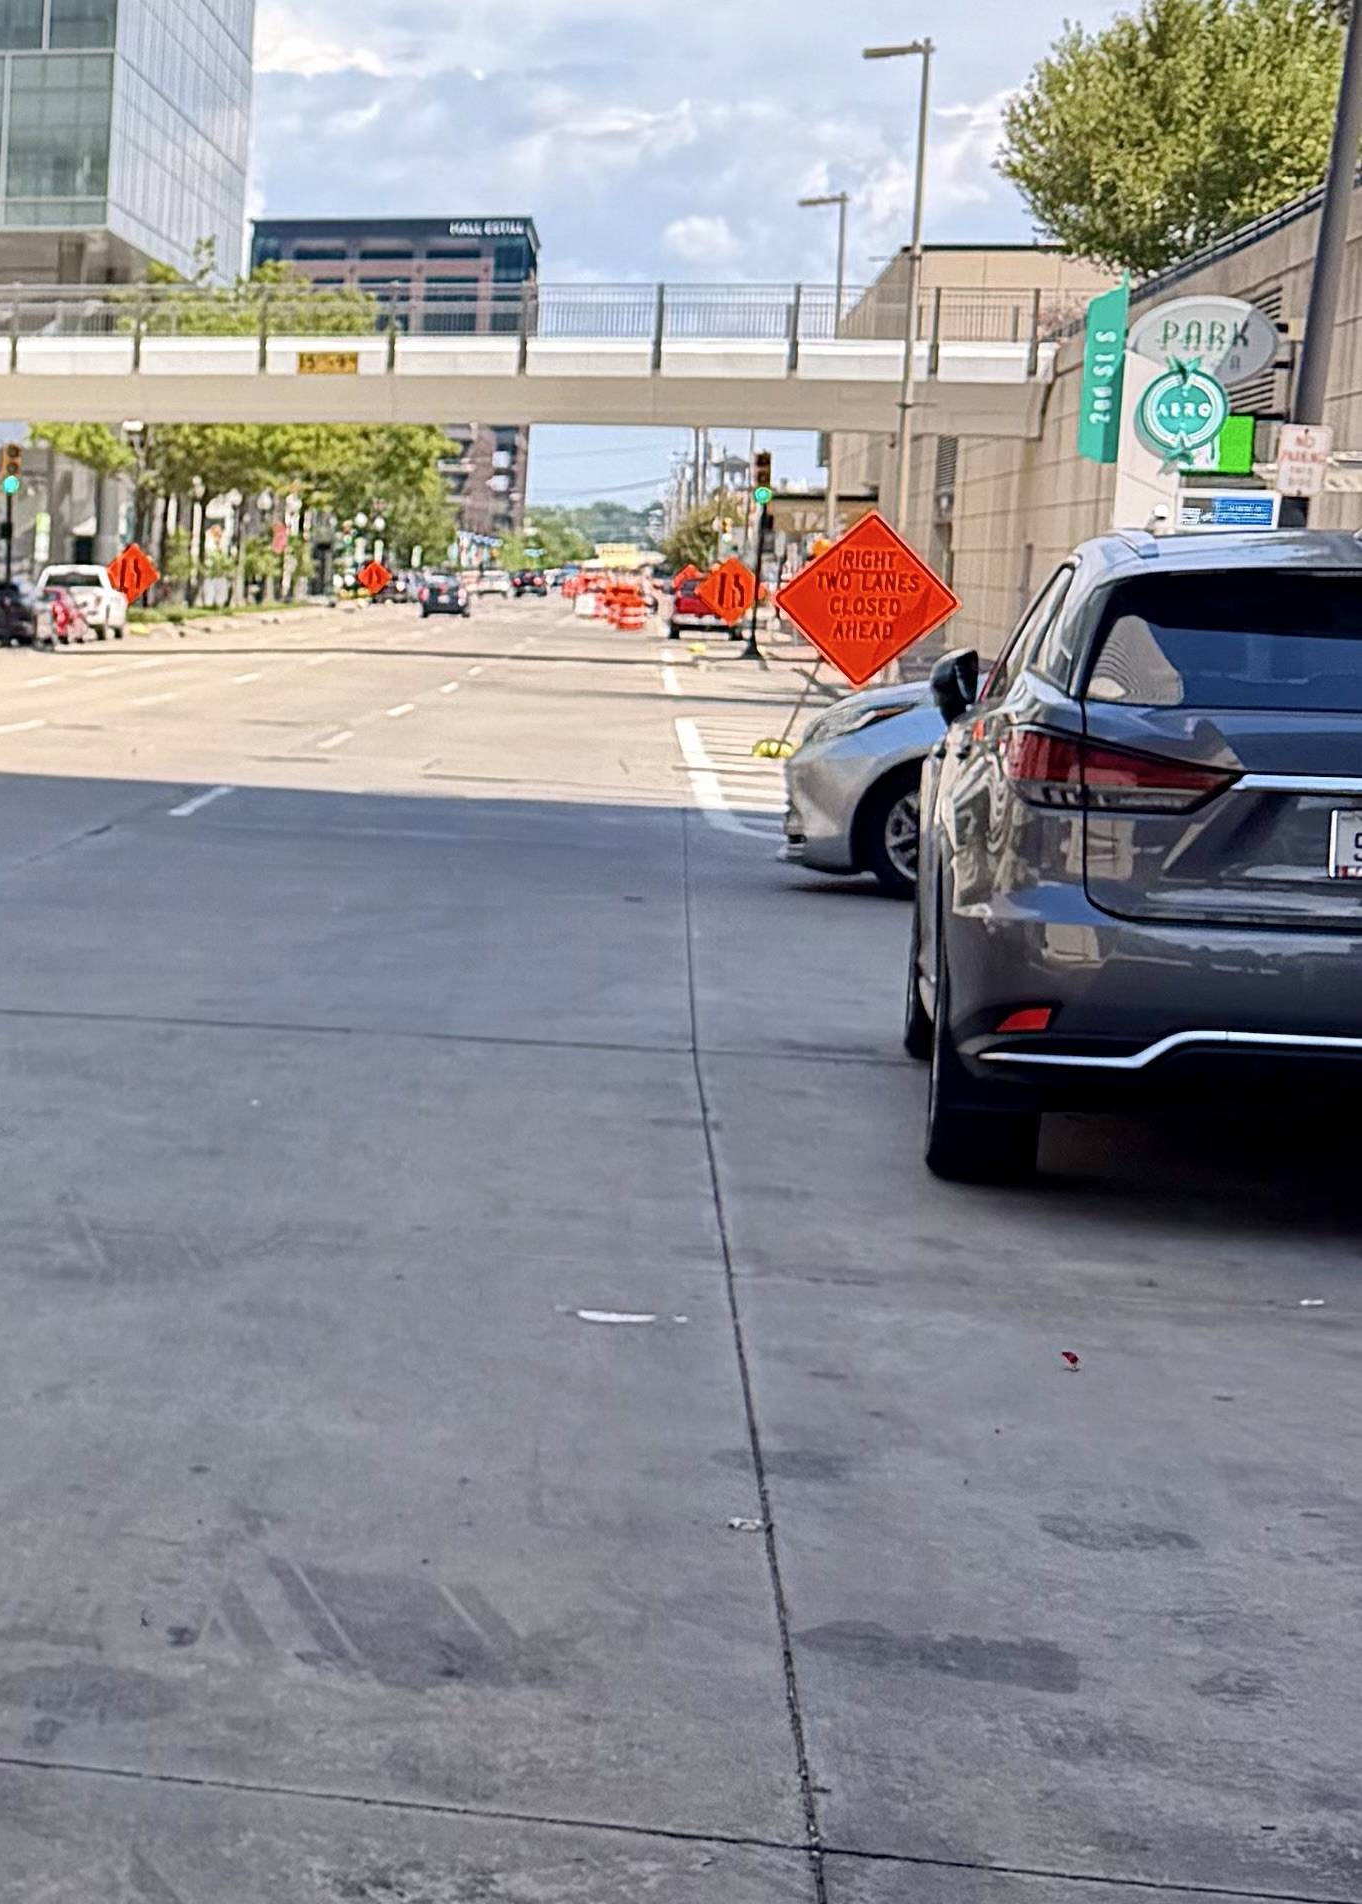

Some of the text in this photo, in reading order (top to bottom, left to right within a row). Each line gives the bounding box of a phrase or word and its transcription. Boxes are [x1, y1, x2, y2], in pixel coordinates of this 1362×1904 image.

[1163, 320, 1249, 347] PARK
[1157, 402, 1212, 417] AERO
[842, 550, 898, 569] RIGHT
[817, 571, 919, 593] TWO LANES
[829, 596, 901, 617] CLOSED
[832, 621, 894, 640] AHEAD
